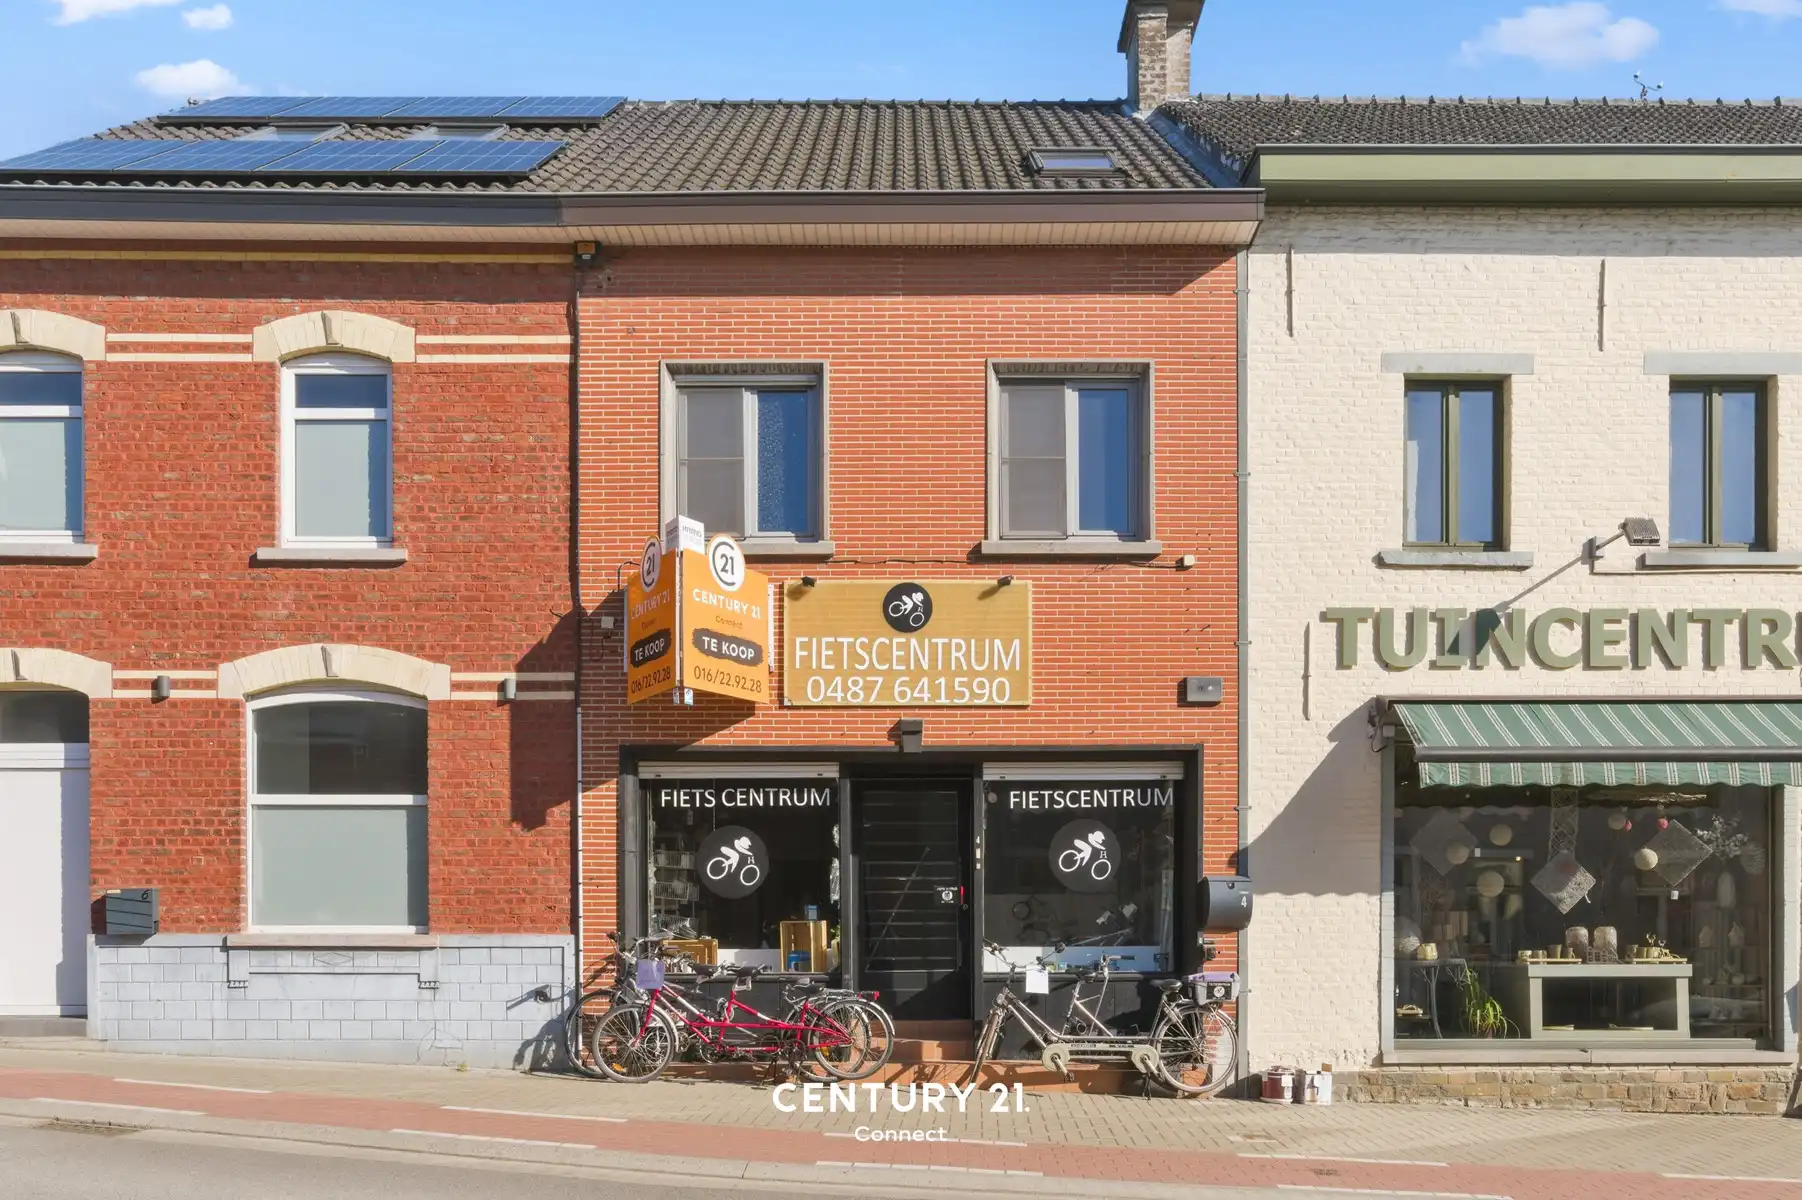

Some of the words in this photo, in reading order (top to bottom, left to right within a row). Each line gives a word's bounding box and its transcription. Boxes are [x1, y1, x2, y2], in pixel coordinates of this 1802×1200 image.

[692, 588, 749, 615] CENTURY
[750, 605, 761, 620] 21
[634, 648, 643, 661] TE
[645, 638, 665, 657] KOOP
[702, 636, 718, 652] TE
[722, 642, 755, 661] KOOP
[795, 637, 1020, 671] FIETSCENTRUM
[631, 665, 671, 693] 016/22.92.28
[693, 665, 762, 693] 016/22.92.28
[806, 676, 884, 703] 0487
[893, 677, 1010, 704] 641590
[661, 789, 716, 808] FIETS
[721, 788, 831, 807] CENTRUM
[1009, 787, 1174, 809] FIETSCENTRUM
[141, 889, 150, 900] 6
[1240, 895, 1248, 908] 4
